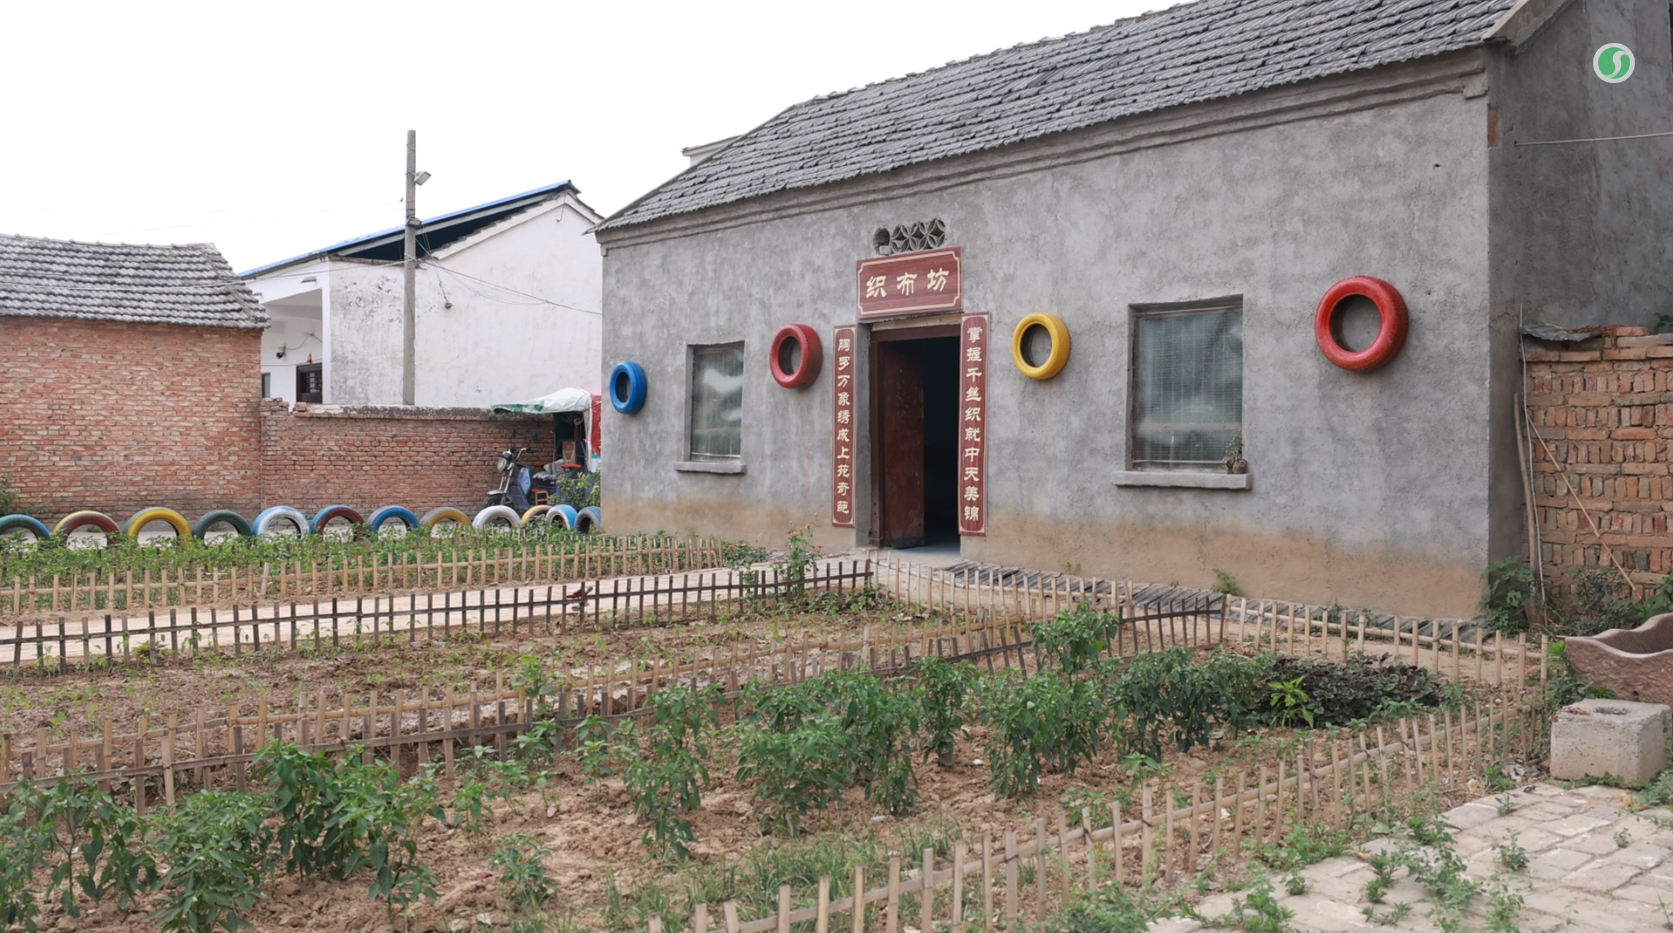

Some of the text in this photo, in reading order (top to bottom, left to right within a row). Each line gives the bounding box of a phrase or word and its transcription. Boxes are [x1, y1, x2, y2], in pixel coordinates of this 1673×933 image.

[866, 268, 949, 298] 织布坊
[964, 326, 983, 521] 掌握千丝织就中天美锦
